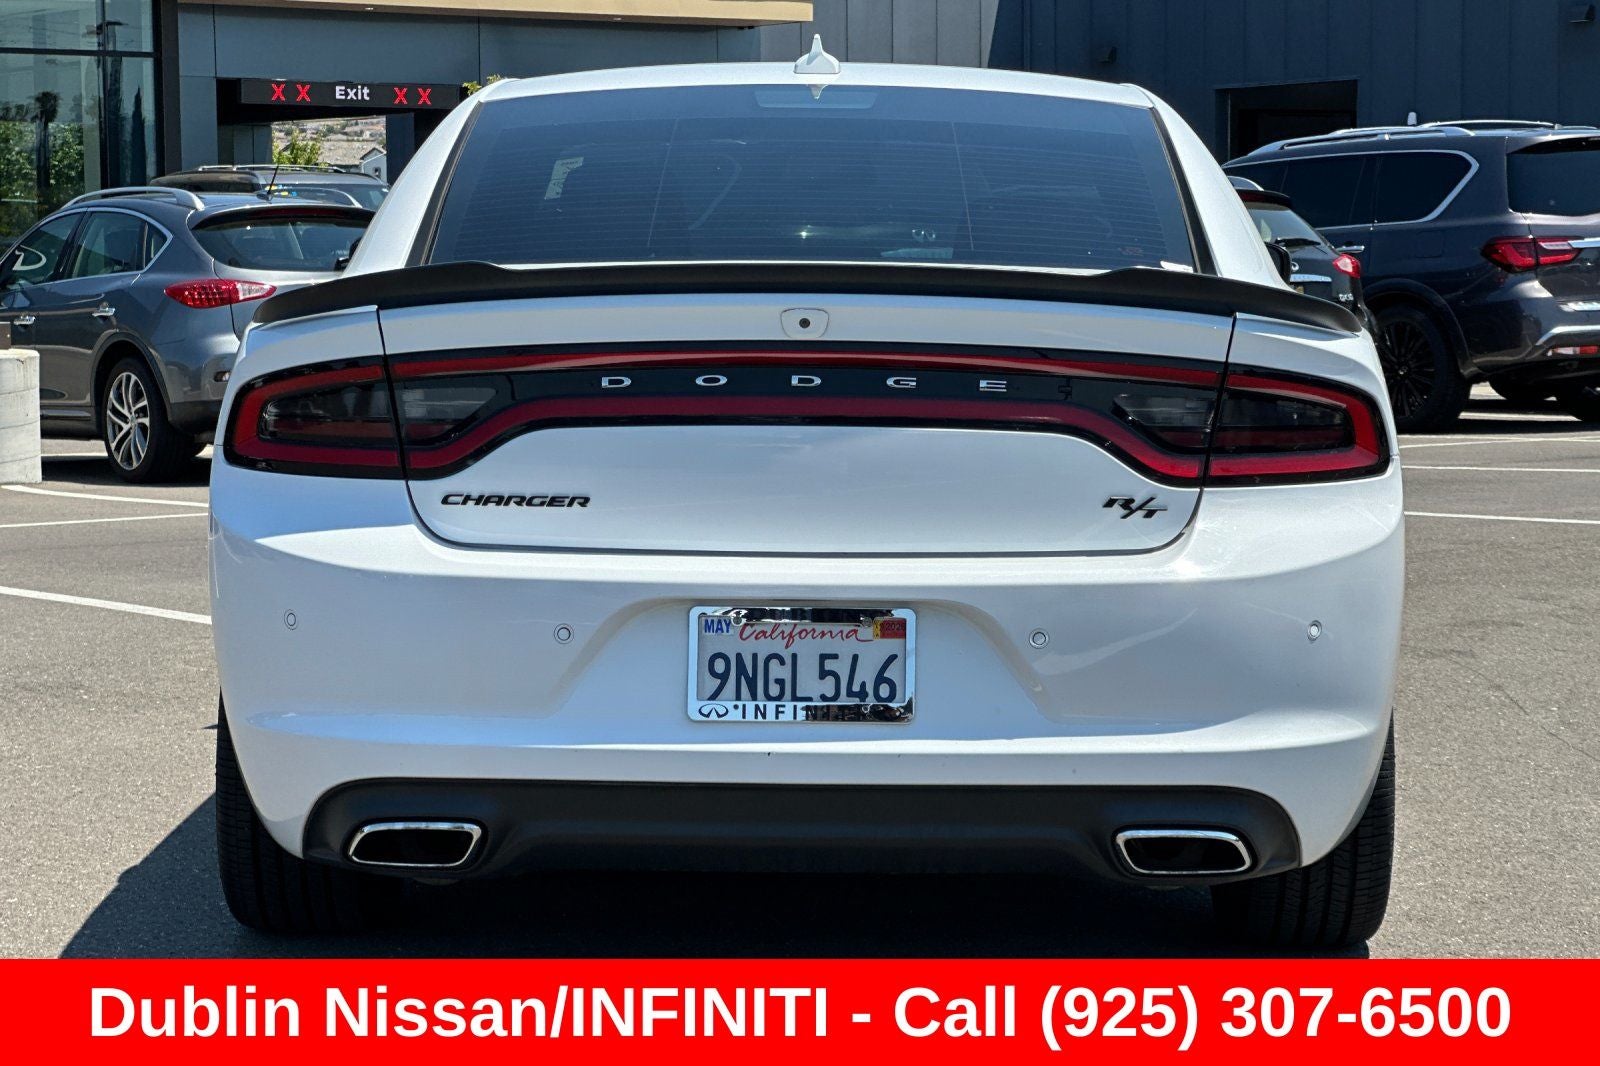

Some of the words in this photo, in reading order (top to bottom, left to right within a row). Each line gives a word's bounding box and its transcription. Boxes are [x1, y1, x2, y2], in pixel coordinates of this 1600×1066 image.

[335, 85, 370, 101] Exit
[601, 374, 1007, 392] DODGE
[440, 493, 591, 508] CHARGER
[1102, 496, 1168, 519] R/T
[704, 618, 731, 634] MAY
[738, 624, 874, 649] California
[707, 652, 899, 703] 9NGL546
